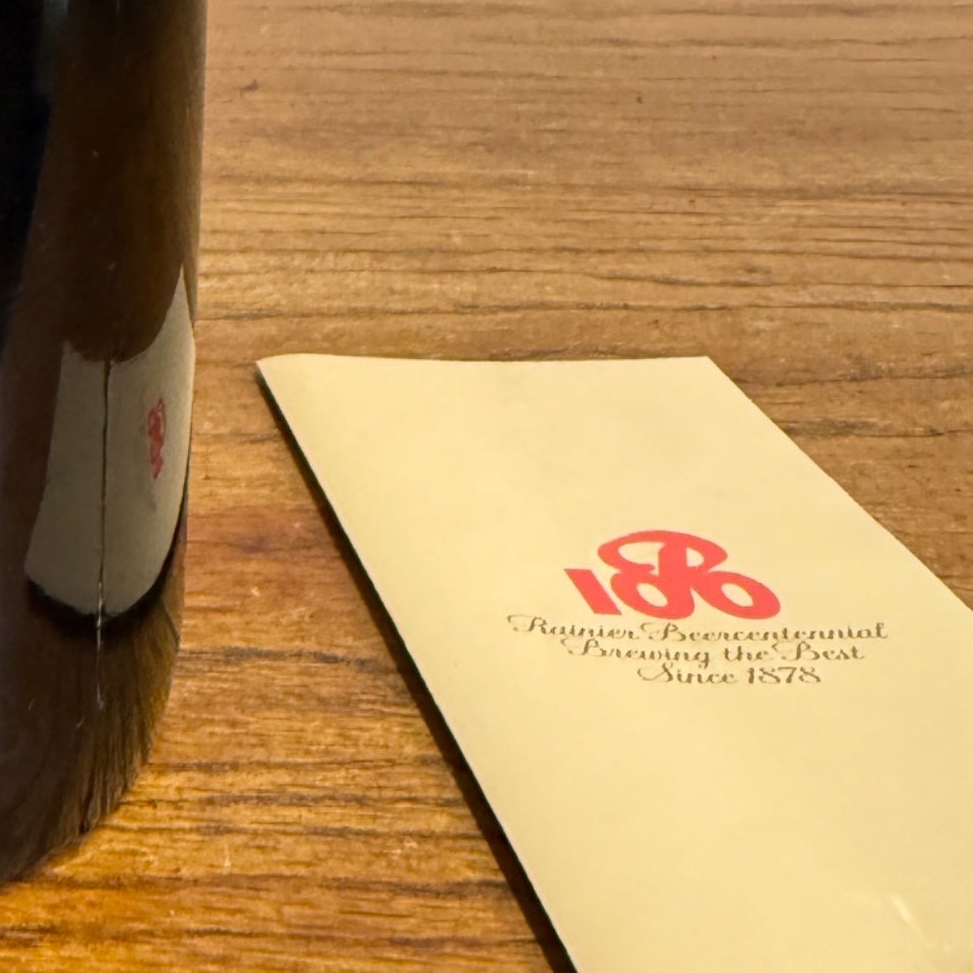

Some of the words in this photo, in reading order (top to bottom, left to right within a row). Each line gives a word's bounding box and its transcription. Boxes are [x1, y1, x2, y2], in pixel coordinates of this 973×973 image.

[507, 614, 639, 640] Rainier
[641, 621, 888, 641] Beercentennial
[560, 638, 710, 667] Brewing
[724, 644, 770, 662] the
[772, 642, 865, 661] Best
[637, 662, 735, 684] Since
[747, 666, 822, 684] 1878
